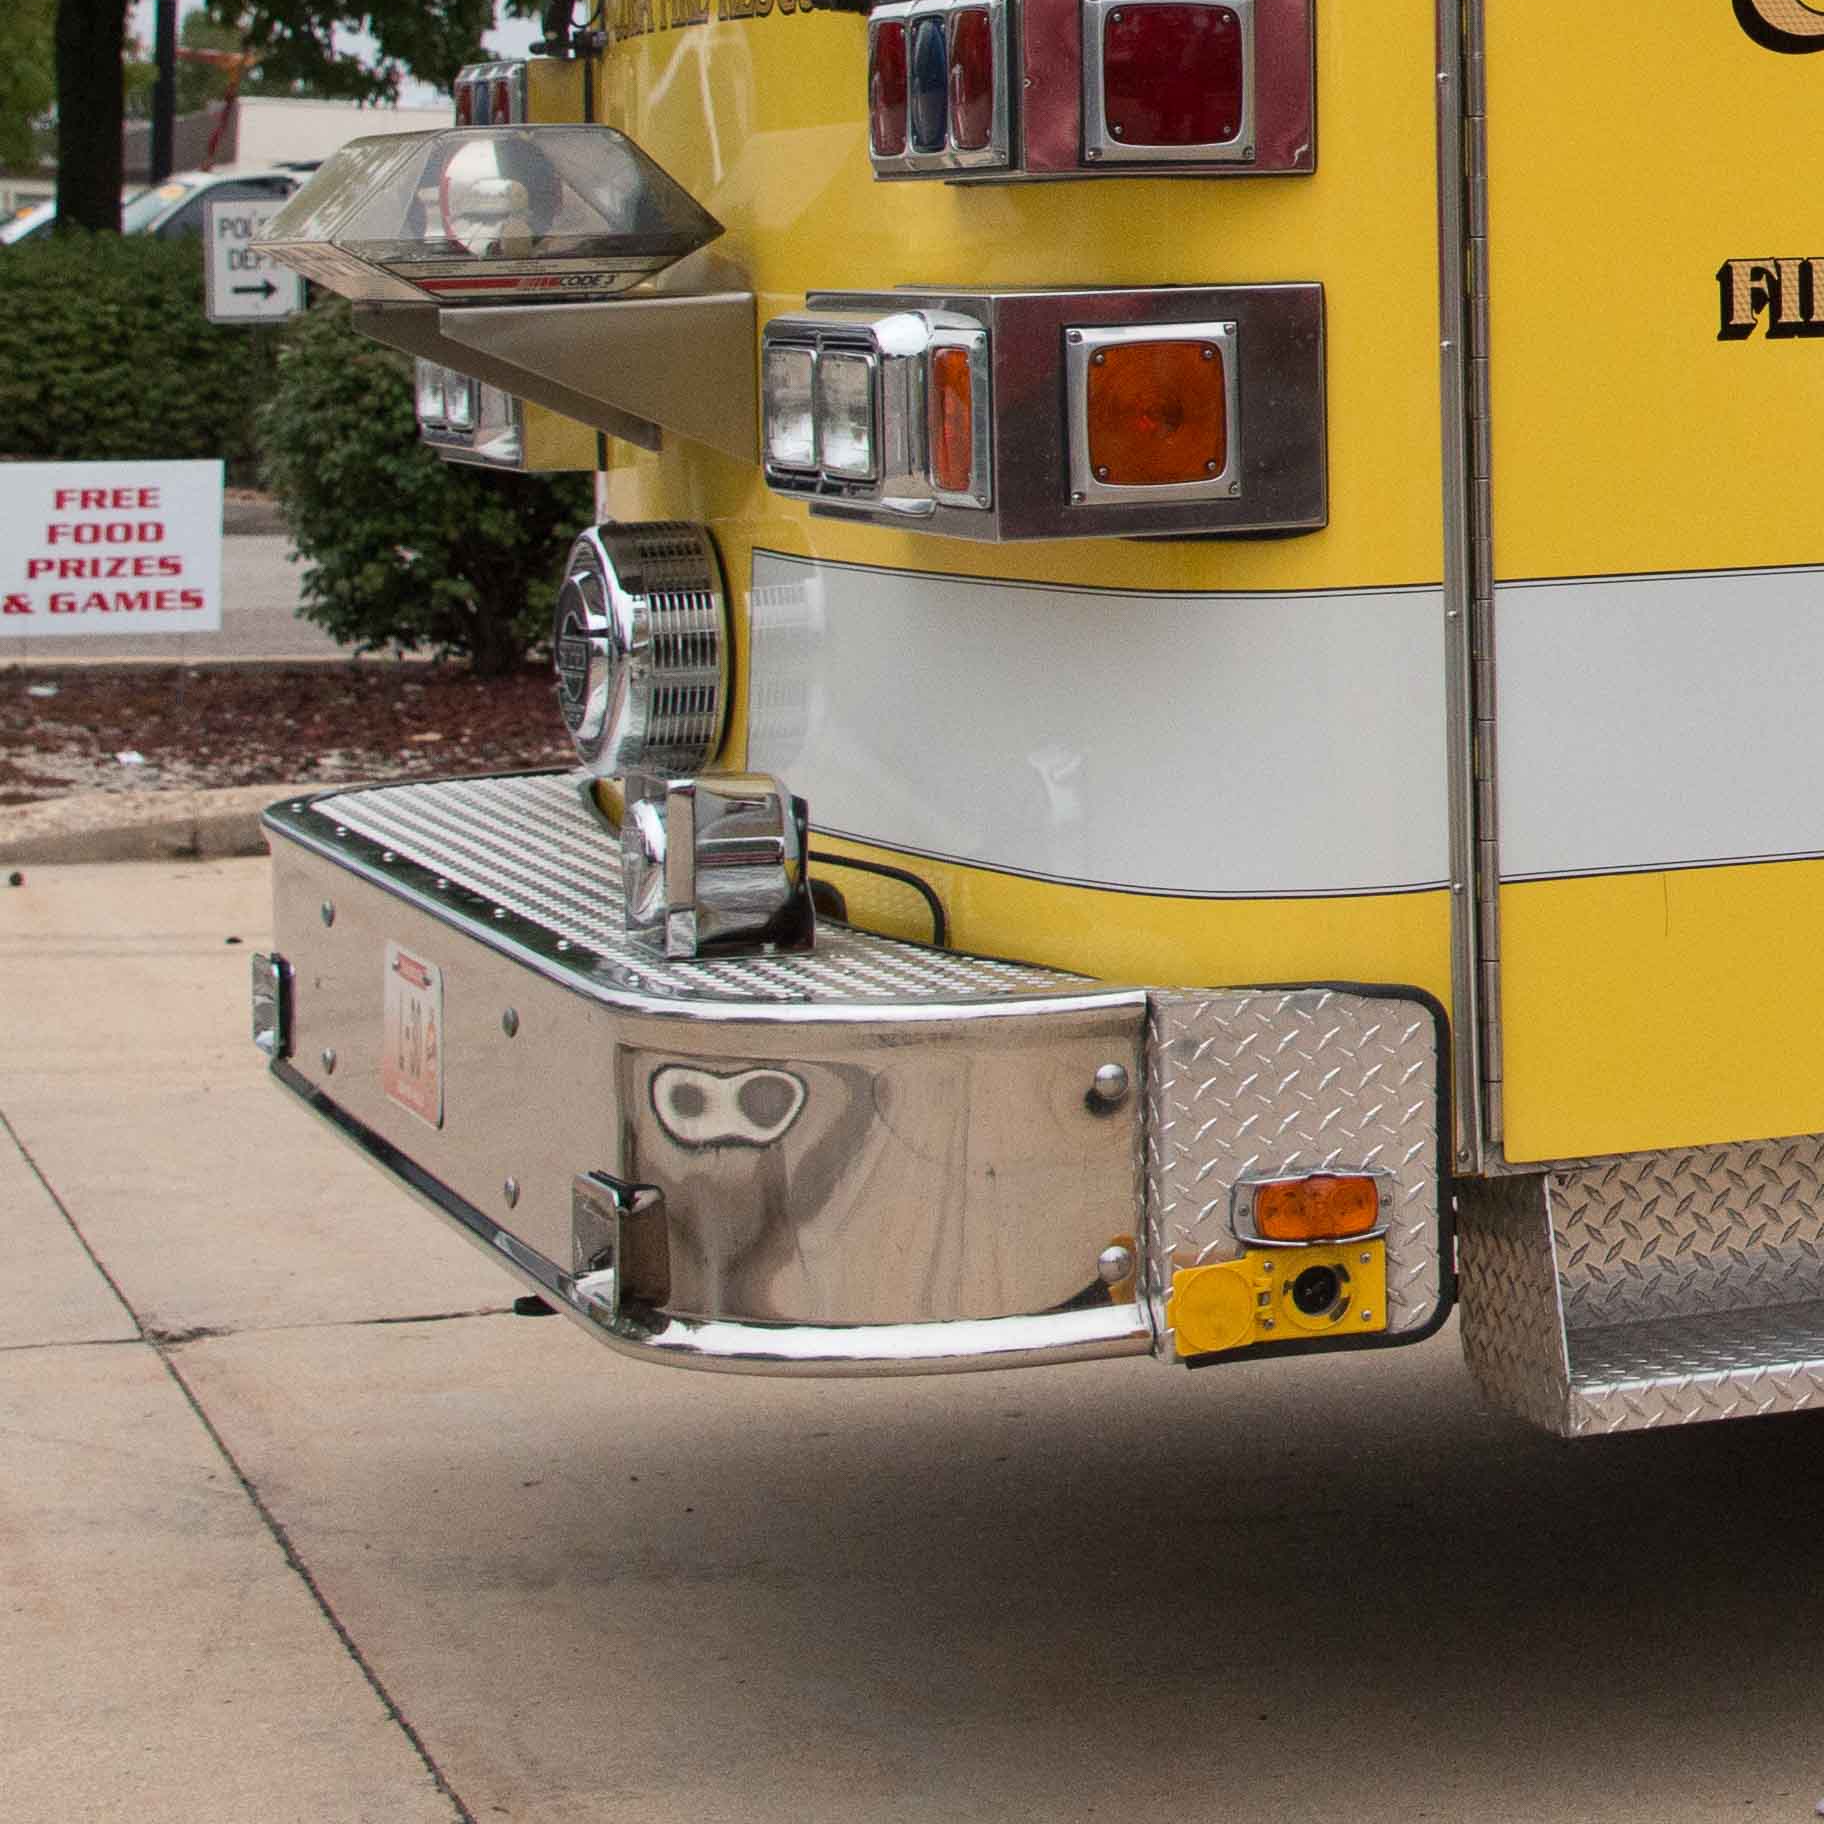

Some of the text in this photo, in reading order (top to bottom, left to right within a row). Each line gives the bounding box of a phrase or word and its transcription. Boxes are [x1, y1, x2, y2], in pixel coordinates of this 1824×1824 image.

[559, 275, 602, 287] CODE
[54, 487, 161, 510] FREE
[46, 521, 166, 545] FOOD
[26, 555, 183, 580] PRIZES
[3, 588, 205, 615] & GAMES
